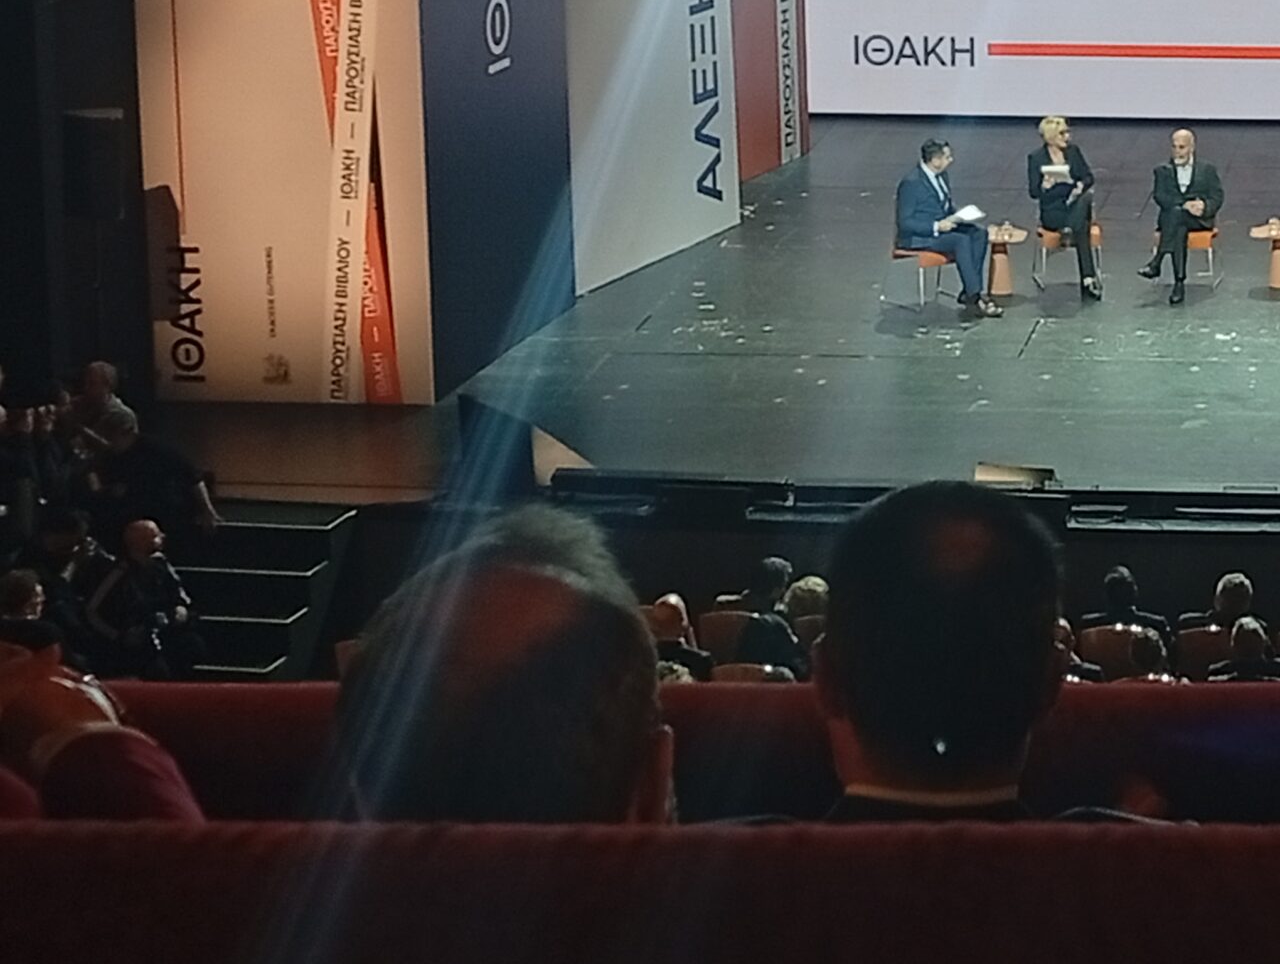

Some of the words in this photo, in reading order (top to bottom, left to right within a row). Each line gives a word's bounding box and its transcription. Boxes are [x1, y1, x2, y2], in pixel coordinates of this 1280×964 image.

[344, 12, 362, 113] ΠΑΡΟΥΣΙΑΣΗ
[780, 9, 794, 147] ΠΑΡΟΥΣΙΑΣΗ
[854, 34, 976, 69] ΙΘΑΚΗ
[340, 149, 355, 201] ΙΘΑΚΗ
[167, 246, 206, 383] ΙΘΑΚΗ
[334, 236, 352, 296] ΒΙΒΛΙΟΥ
[329, 299, 348, 401] ΠΑΡΟΥΣΙΑΣΗ
